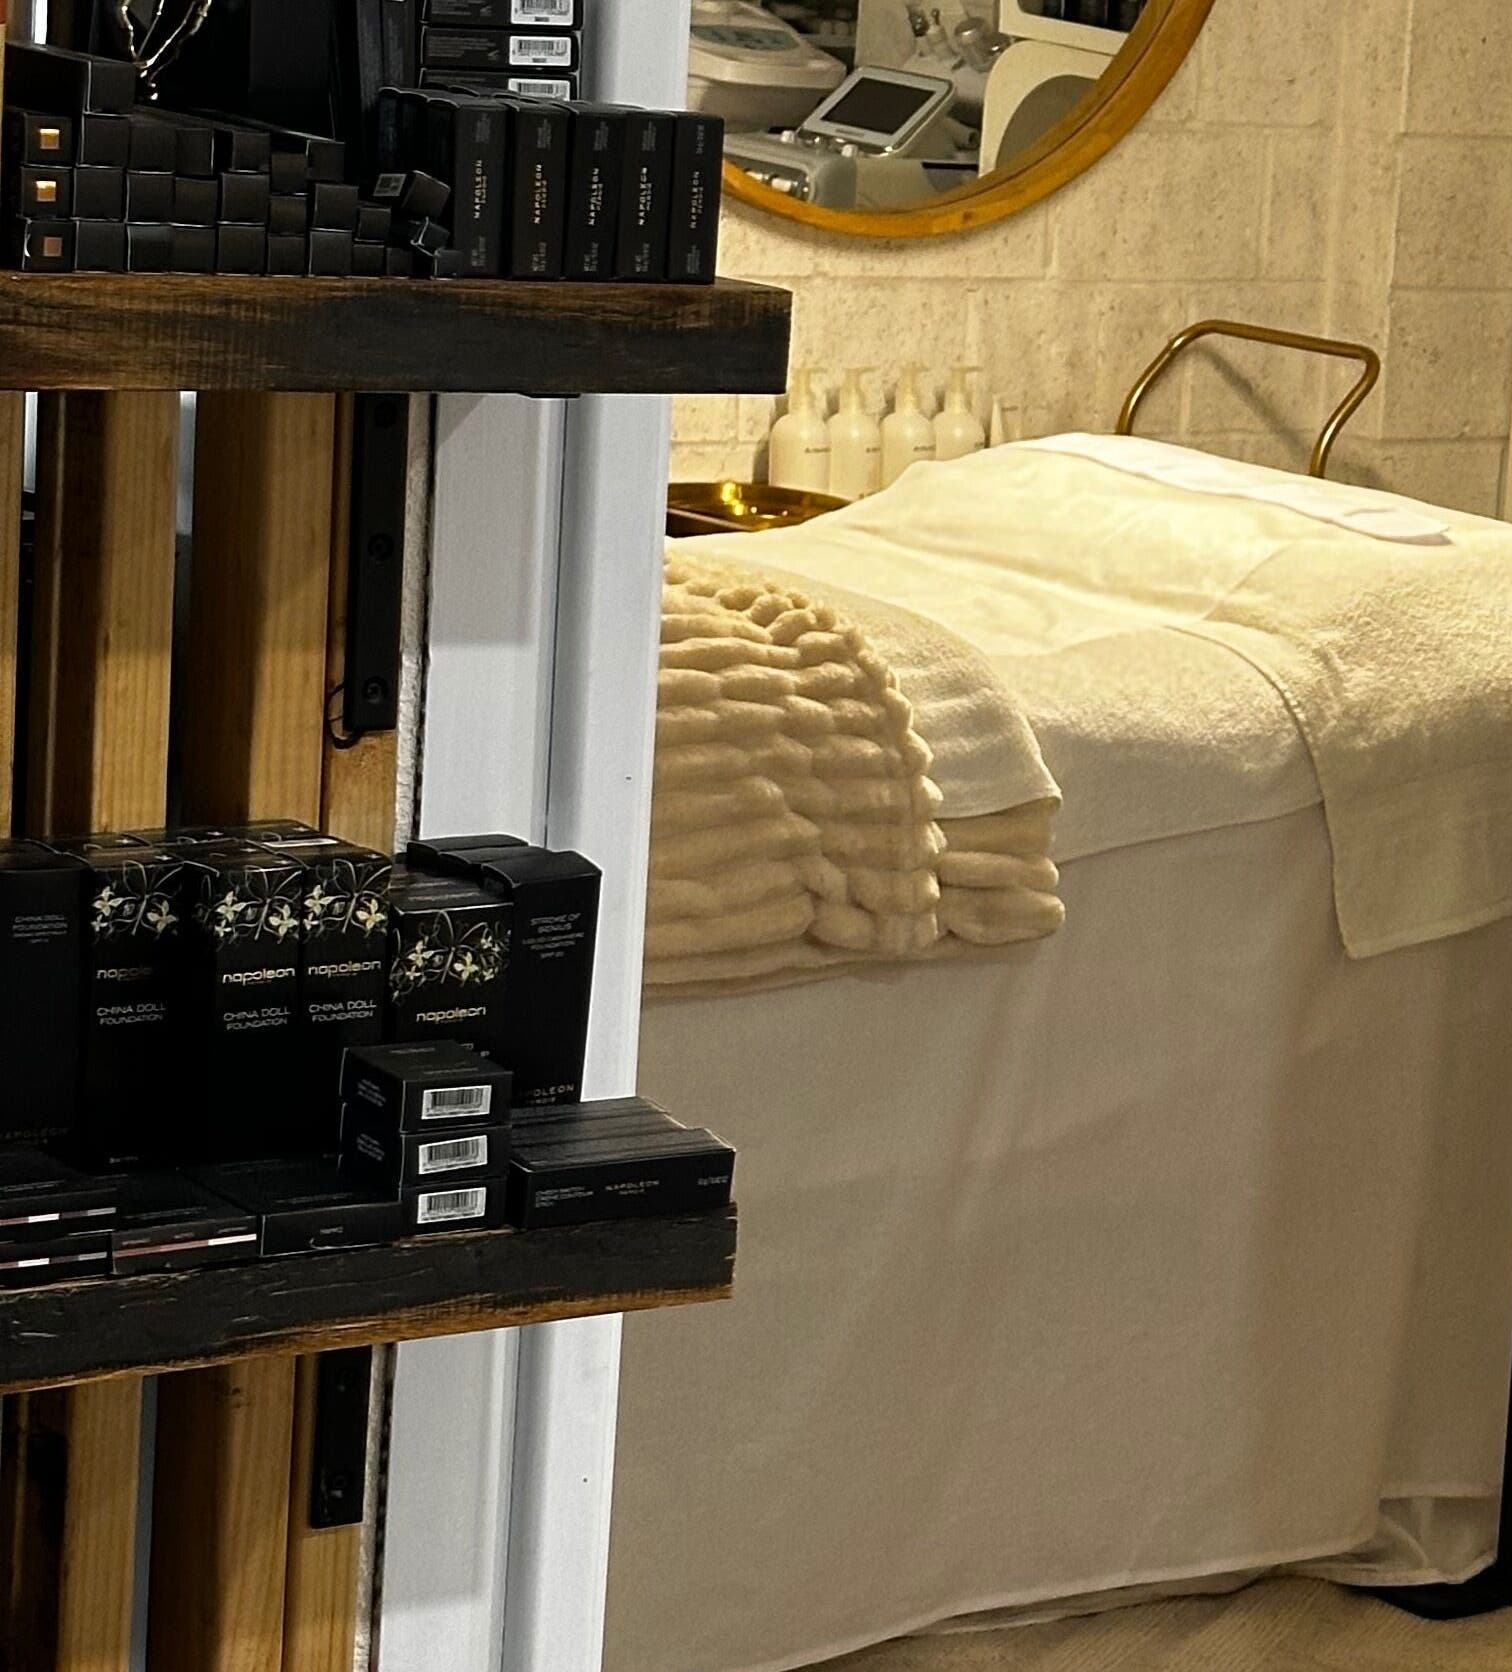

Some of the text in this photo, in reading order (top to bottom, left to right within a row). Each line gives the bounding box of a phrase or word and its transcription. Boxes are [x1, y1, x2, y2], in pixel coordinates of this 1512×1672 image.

[533, 164, 543, 225] NAPOLEON
[222, 966, 296, 986] napoleon
[307, 959, 382, 979] napoleon
[96, 1001, 167, 1018] CHINA DOLL
[223, 1005, 291, 1022] CHINA DOLL
[308, 998, 378, 1014] CHINA DOLL
[415, 1004, 487, 1024] napoleon
[99, 1012, 164, 1026] FOUNDATION
[226, 1016, 289, 1030] FOUNDATION
[311, 1009, 375, 1023] FOUNDATION
